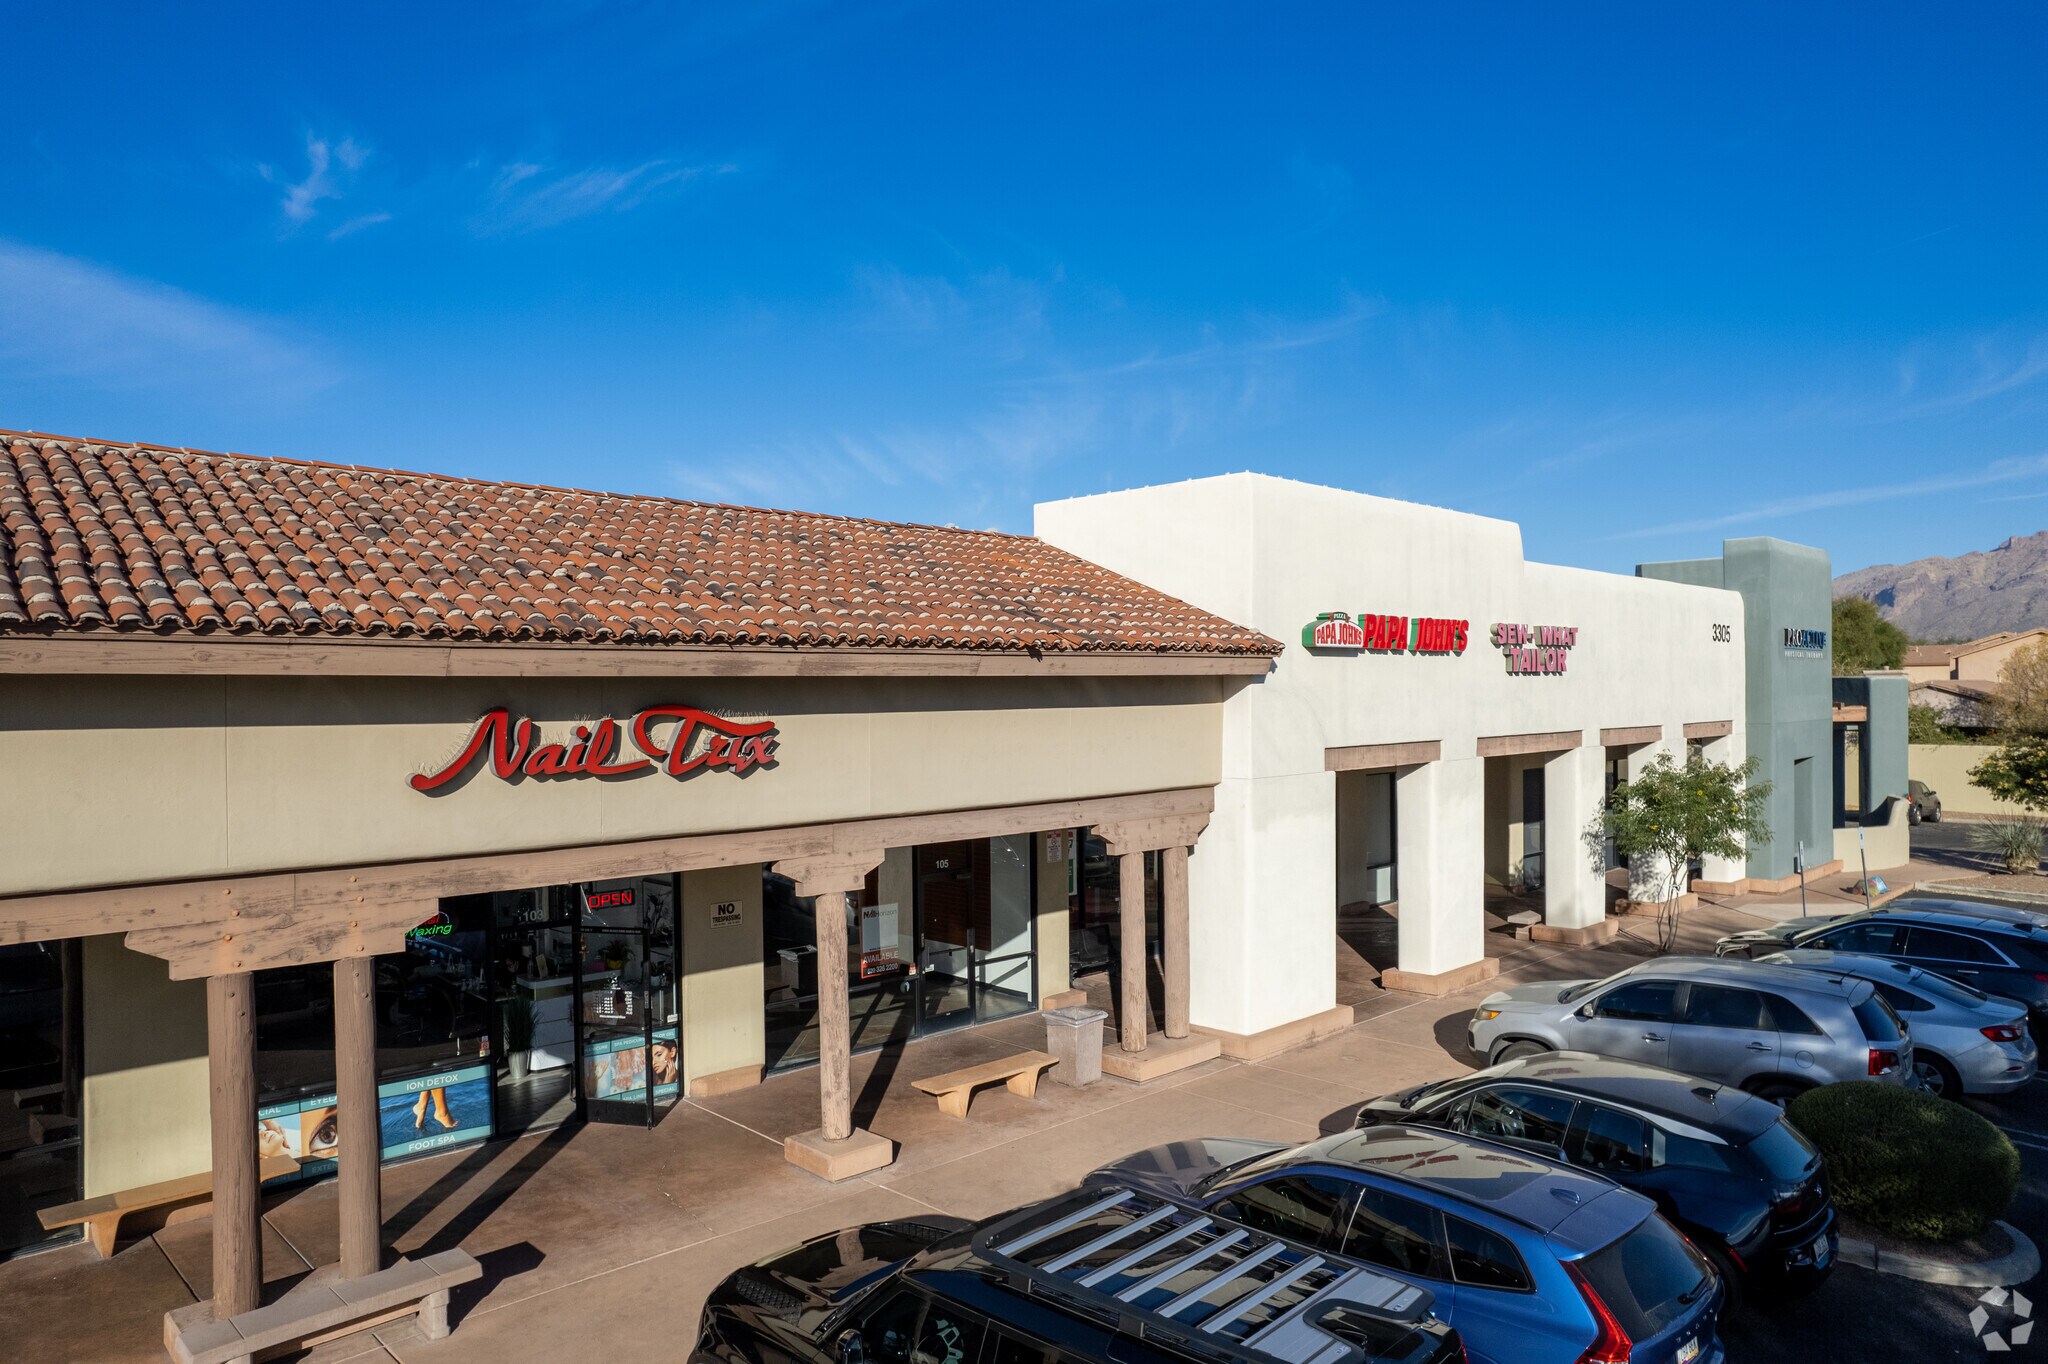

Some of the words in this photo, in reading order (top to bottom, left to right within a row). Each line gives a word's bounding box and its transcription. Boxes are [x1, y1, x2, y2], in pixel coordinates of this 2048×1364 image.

[1316, 622, 1337, 645] PAPA
[1364, 613, 1408, 650] PAPA
[1414, 617, 1469, 652] JOHN'S
[1712, 623, 1730, 643] 3305
[1509, 648, 1567, 672] TAILOR
[407, 706, 651, 791] Nail
[630, 704, 776, 776] Trix
[935, 859, 949, 869] 105
[588, 891, 633, 909] OPEN
[523, 909, 544, 922] 103
[712, 913, 741, 923] TRESPASSING
[717, 903, 735, 916] NO
[863, 950, 899, 964] AVAILABLE
[406, 1079, 424, 1091] ION
[427, 1074, 459, 1088] DETOX
[408, 1139, 435, 1152] FOOT
[437, 1134, 456, 1146] SPA
[311, 1162, 338, 1174] EXTEN
